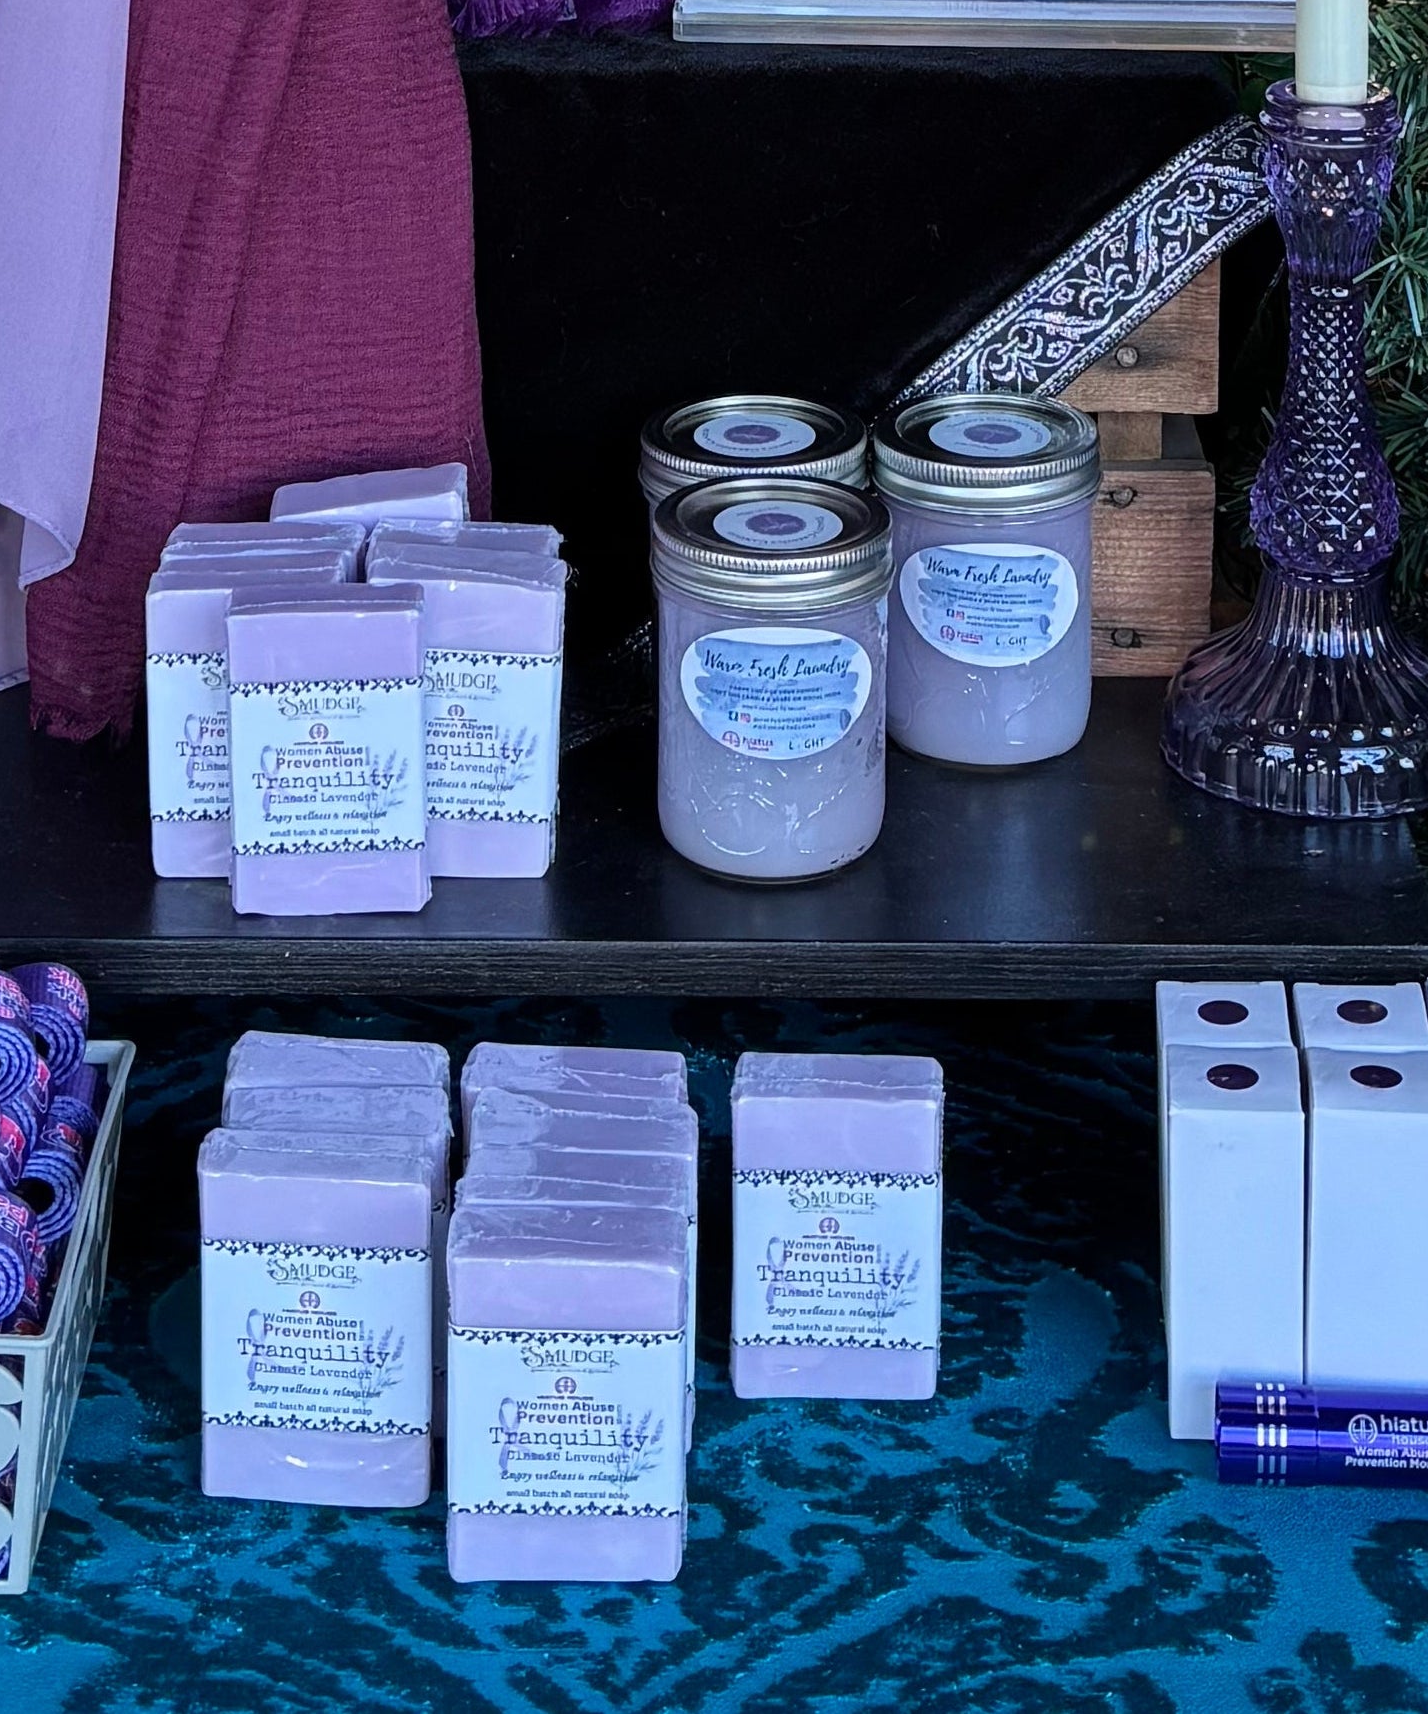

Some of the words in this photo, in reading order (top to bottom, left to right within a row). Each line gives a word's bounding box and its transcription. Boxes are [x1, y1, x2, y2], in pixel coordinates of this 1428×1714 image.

[928, 556, 961, 577] Warm
[965, 564, 1000, 585] Fresh
[276, 747, 322, 756] Women
[325, 746, 363, 755] Abuse
[277, 756, 363, 769] Prevention
[253, 772, 394, 792] Tranquility
[784, 1240, 831, 1250] Women
[835, 1241, 875, 1251] Abuse
[784, 1250, 873, 1264] Prevention
[757, 1265, 905, 1289] Tranquility
[263, 1313, 312, 1324] Women
[317, 1315, 357, 1327] Abuse
[264, 1323, 357, 1341] Prevention
[238, 1338, 390, 1368] Tranquility
[517, 1401, 568, 1412] Women
[572, 1401, 614, 1412] Abuse
[517, 1412, 614, 1425] Prevention
[490, 1427, 648, 1451] Tranquility
[1355, 1446, 1398, 1456] Women
[1346, 1456, 1406, 1468] Prevention
